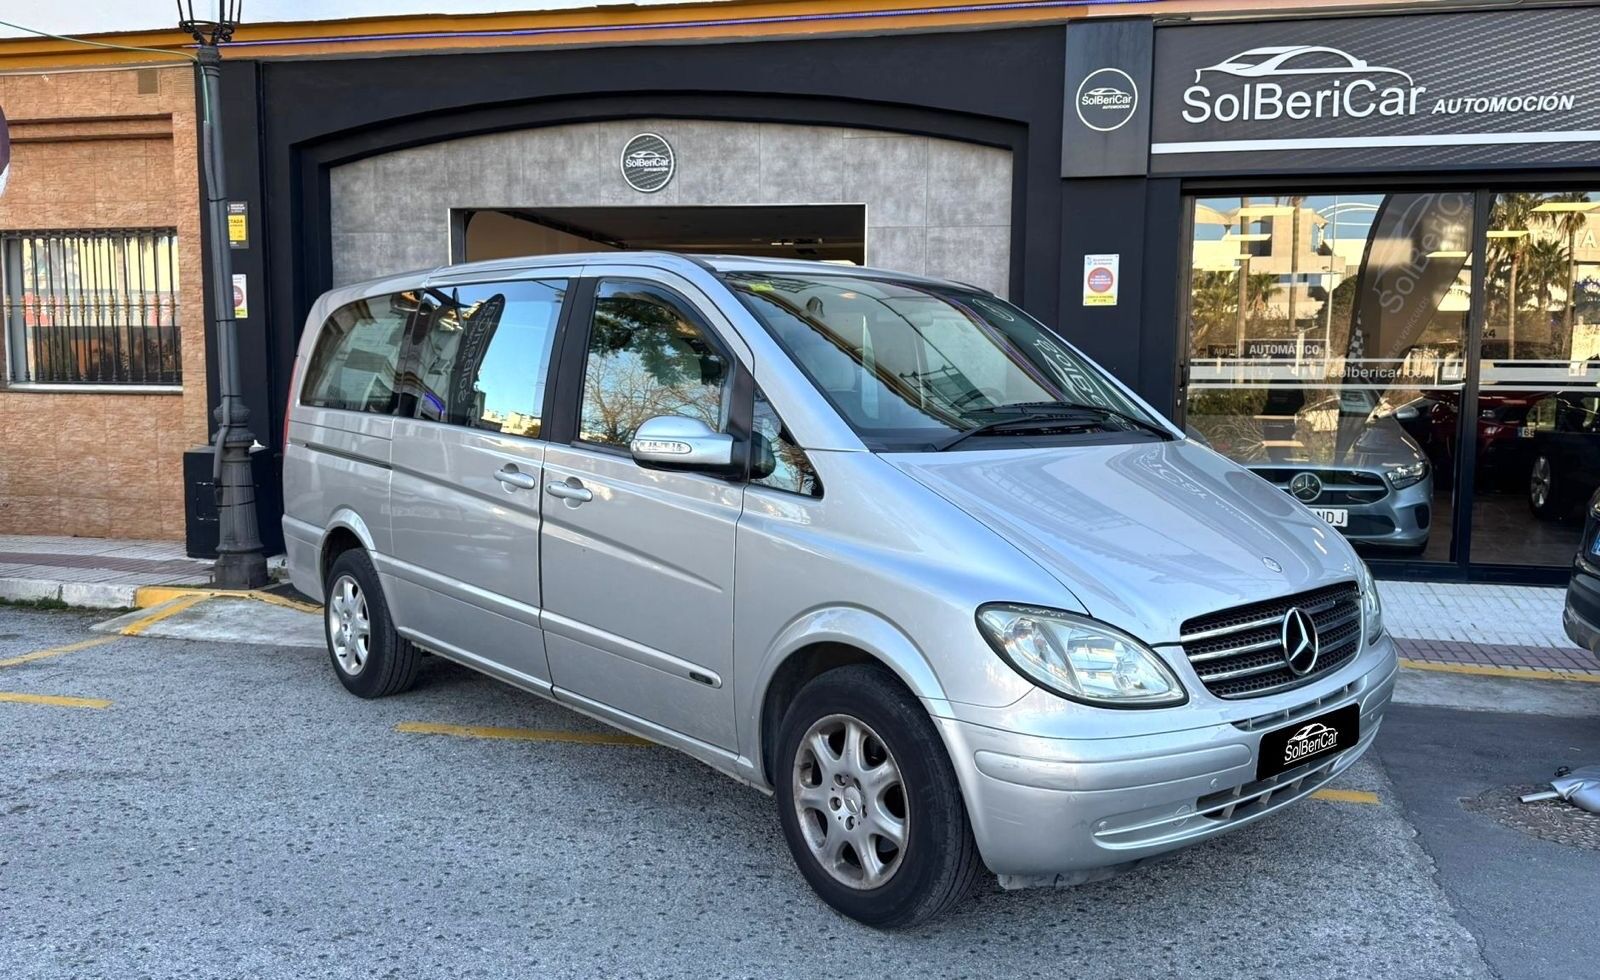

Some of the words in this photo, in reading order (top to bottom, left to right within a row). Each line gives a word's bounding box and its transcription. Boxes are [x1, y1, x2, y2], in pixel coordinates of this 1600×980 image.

[1081, 94, 1132, 105] SolBeriCar
[1181, 79, 1426, 123] SolBeriCar
[1432, 92, 1574, 114] AUTOMOCIÓN
[625, 158, 670, 168] SolBeriCar
[1379, 192, 1466, 314] SolBeriC
[1482, 329, 1496, 338] x4
[1249, 343, 1320, 355] AUTOMÁCO
